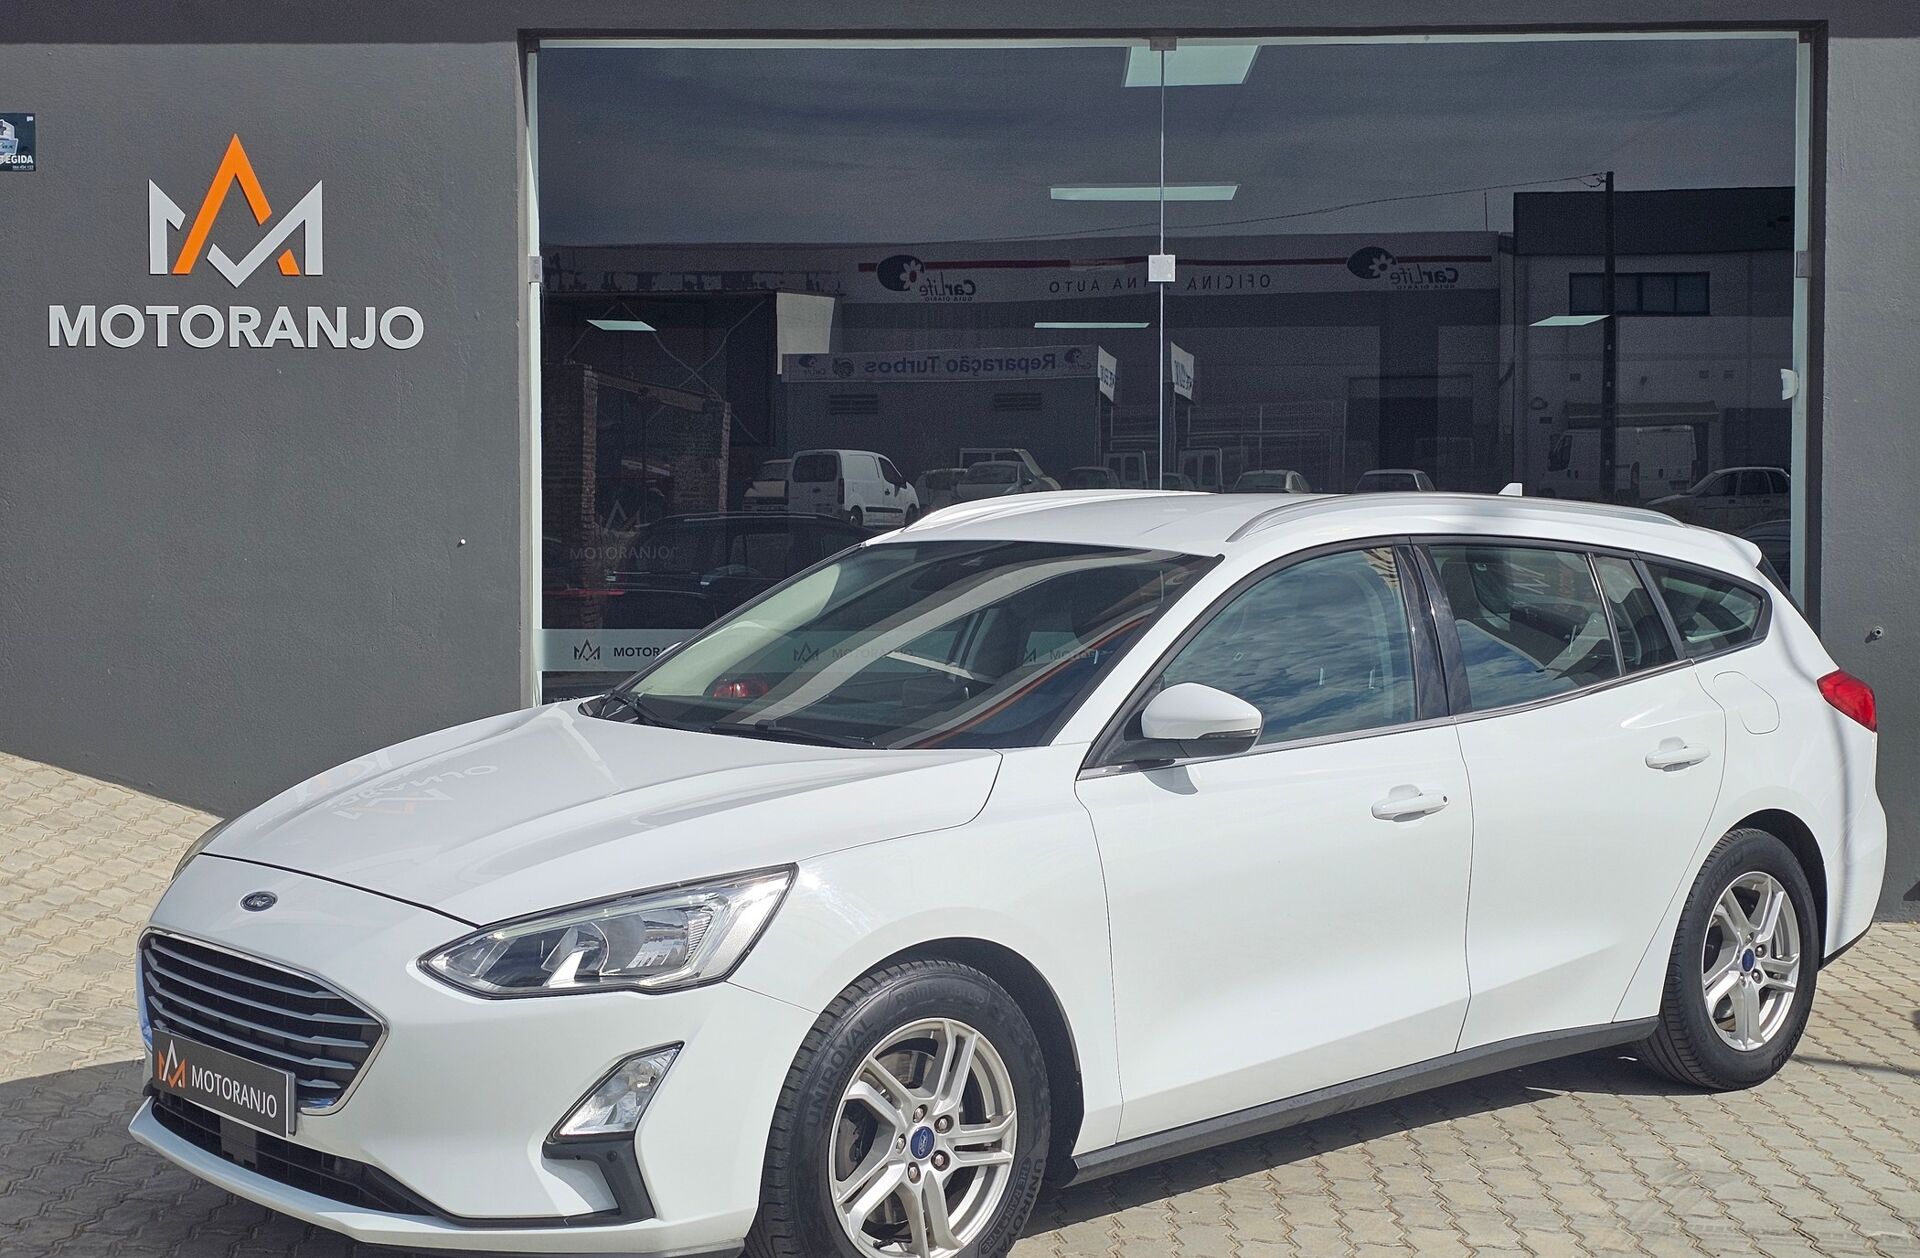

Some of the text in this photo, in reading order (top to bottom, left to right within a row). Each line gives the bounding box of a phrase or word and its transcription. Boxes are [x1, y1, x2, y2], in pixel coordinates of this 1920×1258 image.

[48, 303, 425, 350] MOTORANJO
[190, 1064, 278, 1119] MOTORANJO
[806, 1019, 874, 1127] UNIROYAL
